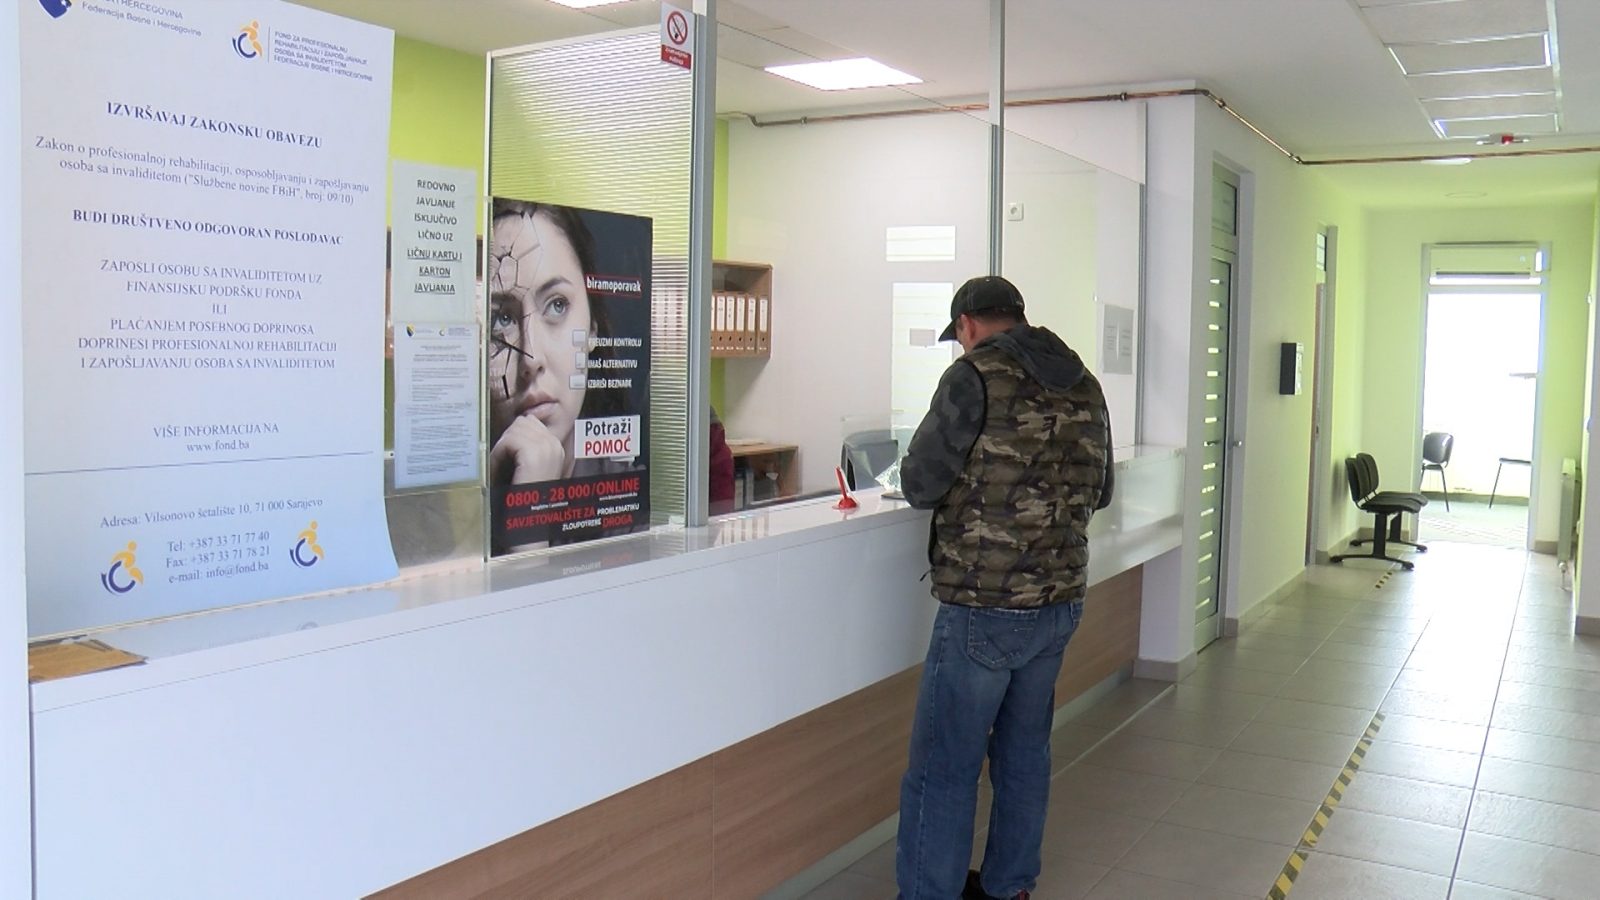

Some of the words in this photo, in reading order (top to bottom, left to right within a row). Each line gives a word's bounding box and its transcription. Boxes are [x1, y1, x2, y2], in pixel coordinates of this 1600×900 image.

[82, 2, 124, 19] Federacija
[126, 13, 151, 24] Bosne
[157, 19, 202, 36] Hercegovine
[107, 101, 187, 127] IZVRŠAVAJ
[190, 116, 263, 139] ZAKONSKU
[266, 129, 323, 149] OBAVEZU
[35, 135, 75, 152] Zakon
[78, 145, 85, 153] o
[88, 146, 166, 168] profesionalnoj
[168, 154, 232, 176] rehabilitaciji,
[235, 167, 307, 185] osposobljavanju
[314, 178, 370, 194] zapošljavanju
[59, 159, 94, 172] osoba
[97, 165, 109, 174] sa
[112, 165, 182, 184] invaliditetom
[239, 183, 269, 194] novine
[417, 179, 456, 192] REDOVNO
[416, 196, 455, 208] JAVLJANJE
[73, 208, 108, 224] BUDI
[111, 213, 192, 232] DRUŠTVENO
[194, 221, 272, 239] ODGOVORAN
[274, 229, 344, 246] POSLODAVAC
[414, 212, 457, 225] ISKLJUČIVO
[418, 230, 441, 240] LIČNO
[442, 233, 453, 242] UZ
[407, 246, 431, 259] LIČNU
[432, 250, 458, 260] KARTU
[100, 259, 156, 274] ZAPOSLI
[158, 265, 200, 277] OSOBU
[203, 266, 218, 277] SA
[221, 267, 307, 284] INVALIDITETOM
[309, 273, 323, 284] UZ
[419, 266, 451, 276] KARTON
[126, 281, 207, 296] FINANSIJSKU
[209, 284, 263, 298] PODRŠKU
[265, 289, 302, 300] FONDA
[414, 282, 456, 293] JAVLJANJA
[586, 276, 642, 294] biramoporavak
[212, 303, 227, 315] ILI
[110, 316, 186, 332] PLAĆANJEM
[189, 321, 251, 333] POSEBNOG
[253, 322, 315, 335] DOPRINOSA
[78, 338, 149, 350] DOPRINESI
[152, 339, 255, 351] PROFESIONALNOJ
[257, 340, 337, 352] REHABILITACIJI
[613, 337, 642, 347] KONTROLU
[81, 358, 86, 368] I
[89, 354, 192, 369] ZAPOŠLJAVANJU
[194, 357, 234, 369] OSOBA
[236, 358, 251, 369] SA
[253, 358, 335, 370] INVALIDITETOM
[602, 359, 638, 369] ALTERNATIVU
[153, 424, 181, 438] VIŠE
[184, 423, 261, 437] INFORMACIJA
[263, 422, 280, 433] NA
[585, 418, 631, 437] Potraži
[186, 440, 250, 452] www.fond.ba
[585, 435, 631, 456] POMOĆ
[506, 490, 540, 507] 0800
[549, 487, 566, 502] 28
[100, 516, 141, 528] Adresa:
[144, 508, 195, 523] Vilsonovo
[198, 506, 235, 518] šetalište
[238, 504, 253, 516] 10,
[255, 502, 265, 512] 71
[267, 501, 284, 511] 000
[286, 498, 323, 511] Sarajevo
[506, 507, 582, 530] SAVJETOVALIŠTE
[583, 507, 596, 518] ZA
[596, 502, 640, 516] PROBLEMATIKU
[602, 513, 634, 528] DROGA
[168, 541, 185, 552] Tel:
[189, 537, 213, 549] +387
[216, 536, 228, 547] 33
[231, 534, 242, 544] 71
[245, 532, 256, 543] 77
[257, 531, 270, 542] 40
[166, 557, 188, 569] Fax:
[190, 553, 215, 565] +387
[218, 551, 230, 562] 33
[232, 549, 243, 559] 71
[246, 548, 258, 558] 78
[259, 546, 270, 557] 21
[168, 569, 204, 584] e-mail:
[205, 562, 269, 579] info@fond.ba
